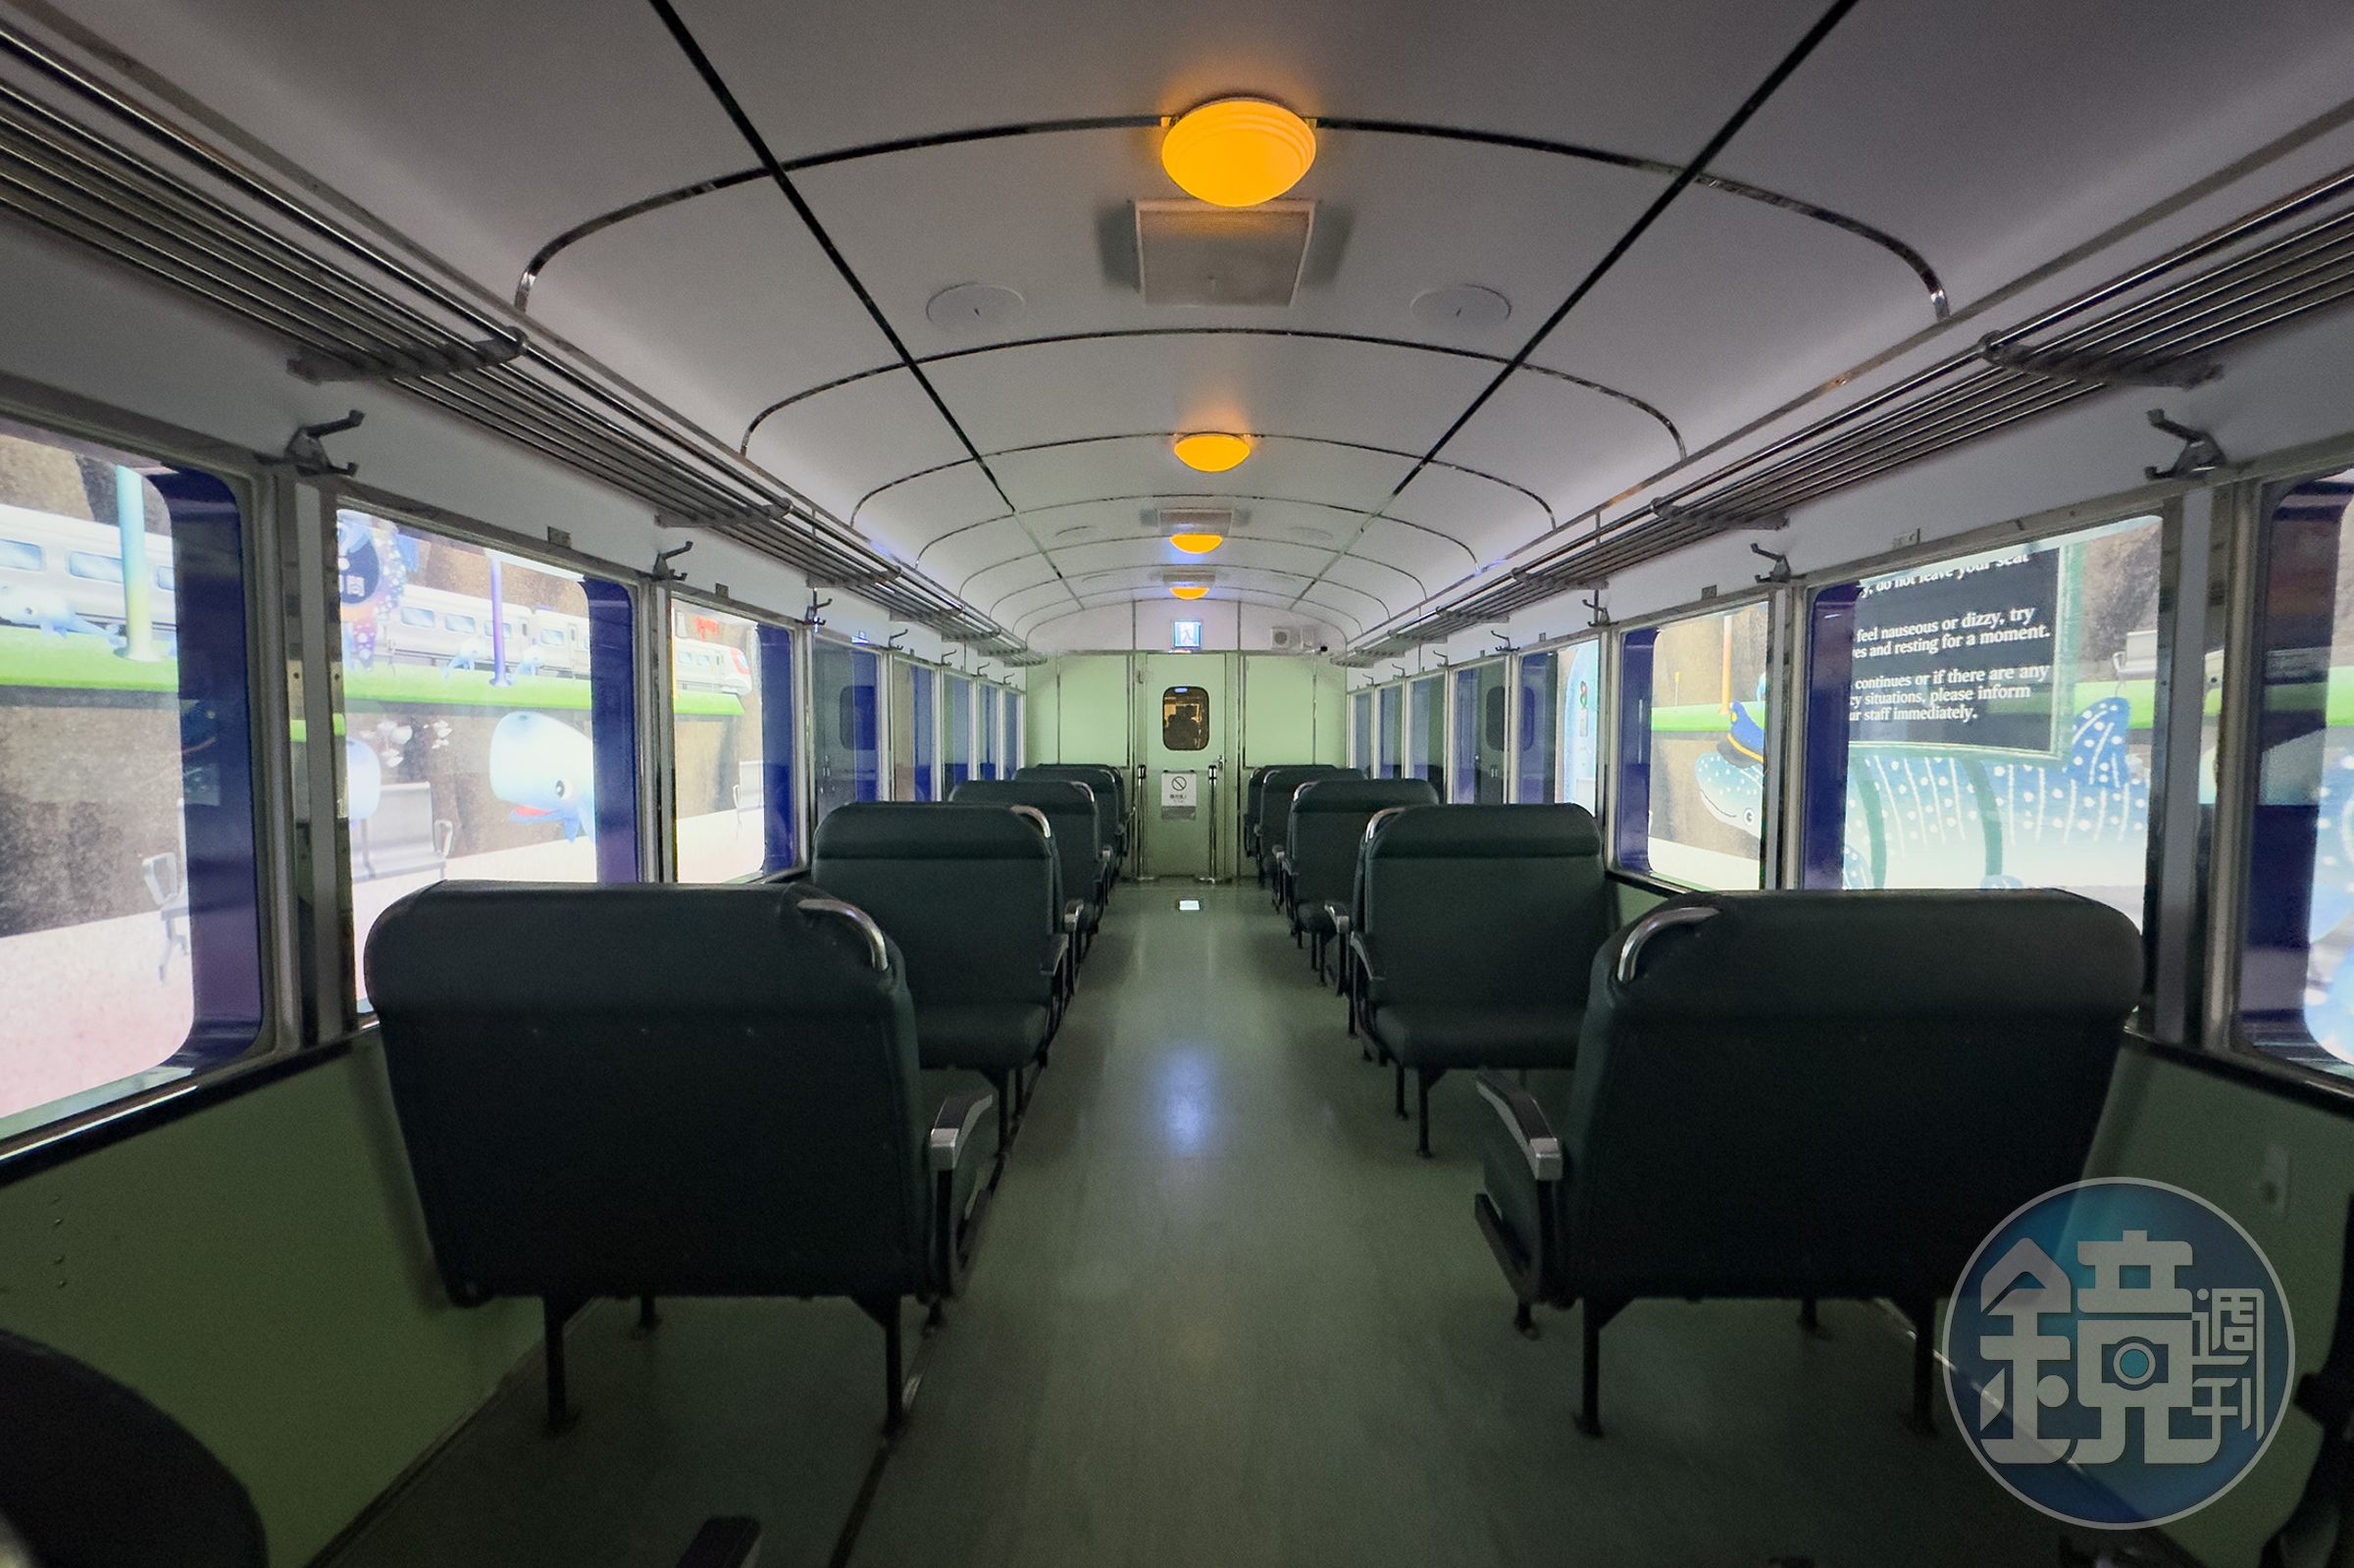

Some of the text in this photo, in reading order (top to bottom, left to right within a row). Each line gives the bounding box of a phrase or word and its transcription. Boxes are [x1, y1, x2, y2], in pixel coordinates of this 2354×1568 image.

[1857, 607, 2035, 642] feel nauseous or dizzy, try
[1869, 640, 1892, 658] and
[1894, 637, 1940, 655] resting
[1942, 632, 1964, 649] for
[1966, 633, 1976, 646] a
[1980, 625, 2050, 644] moment.
[1855, 665, 2051, 690] continues or if there are any
[1864, 690, 1926, 705] situations,
[1929, 686, 1974, 707] please
[1977, 683, 2031, 700] inform
[1864, 706, 1892, 722] staff
[1893, 704, 1978, 724] immediately.
